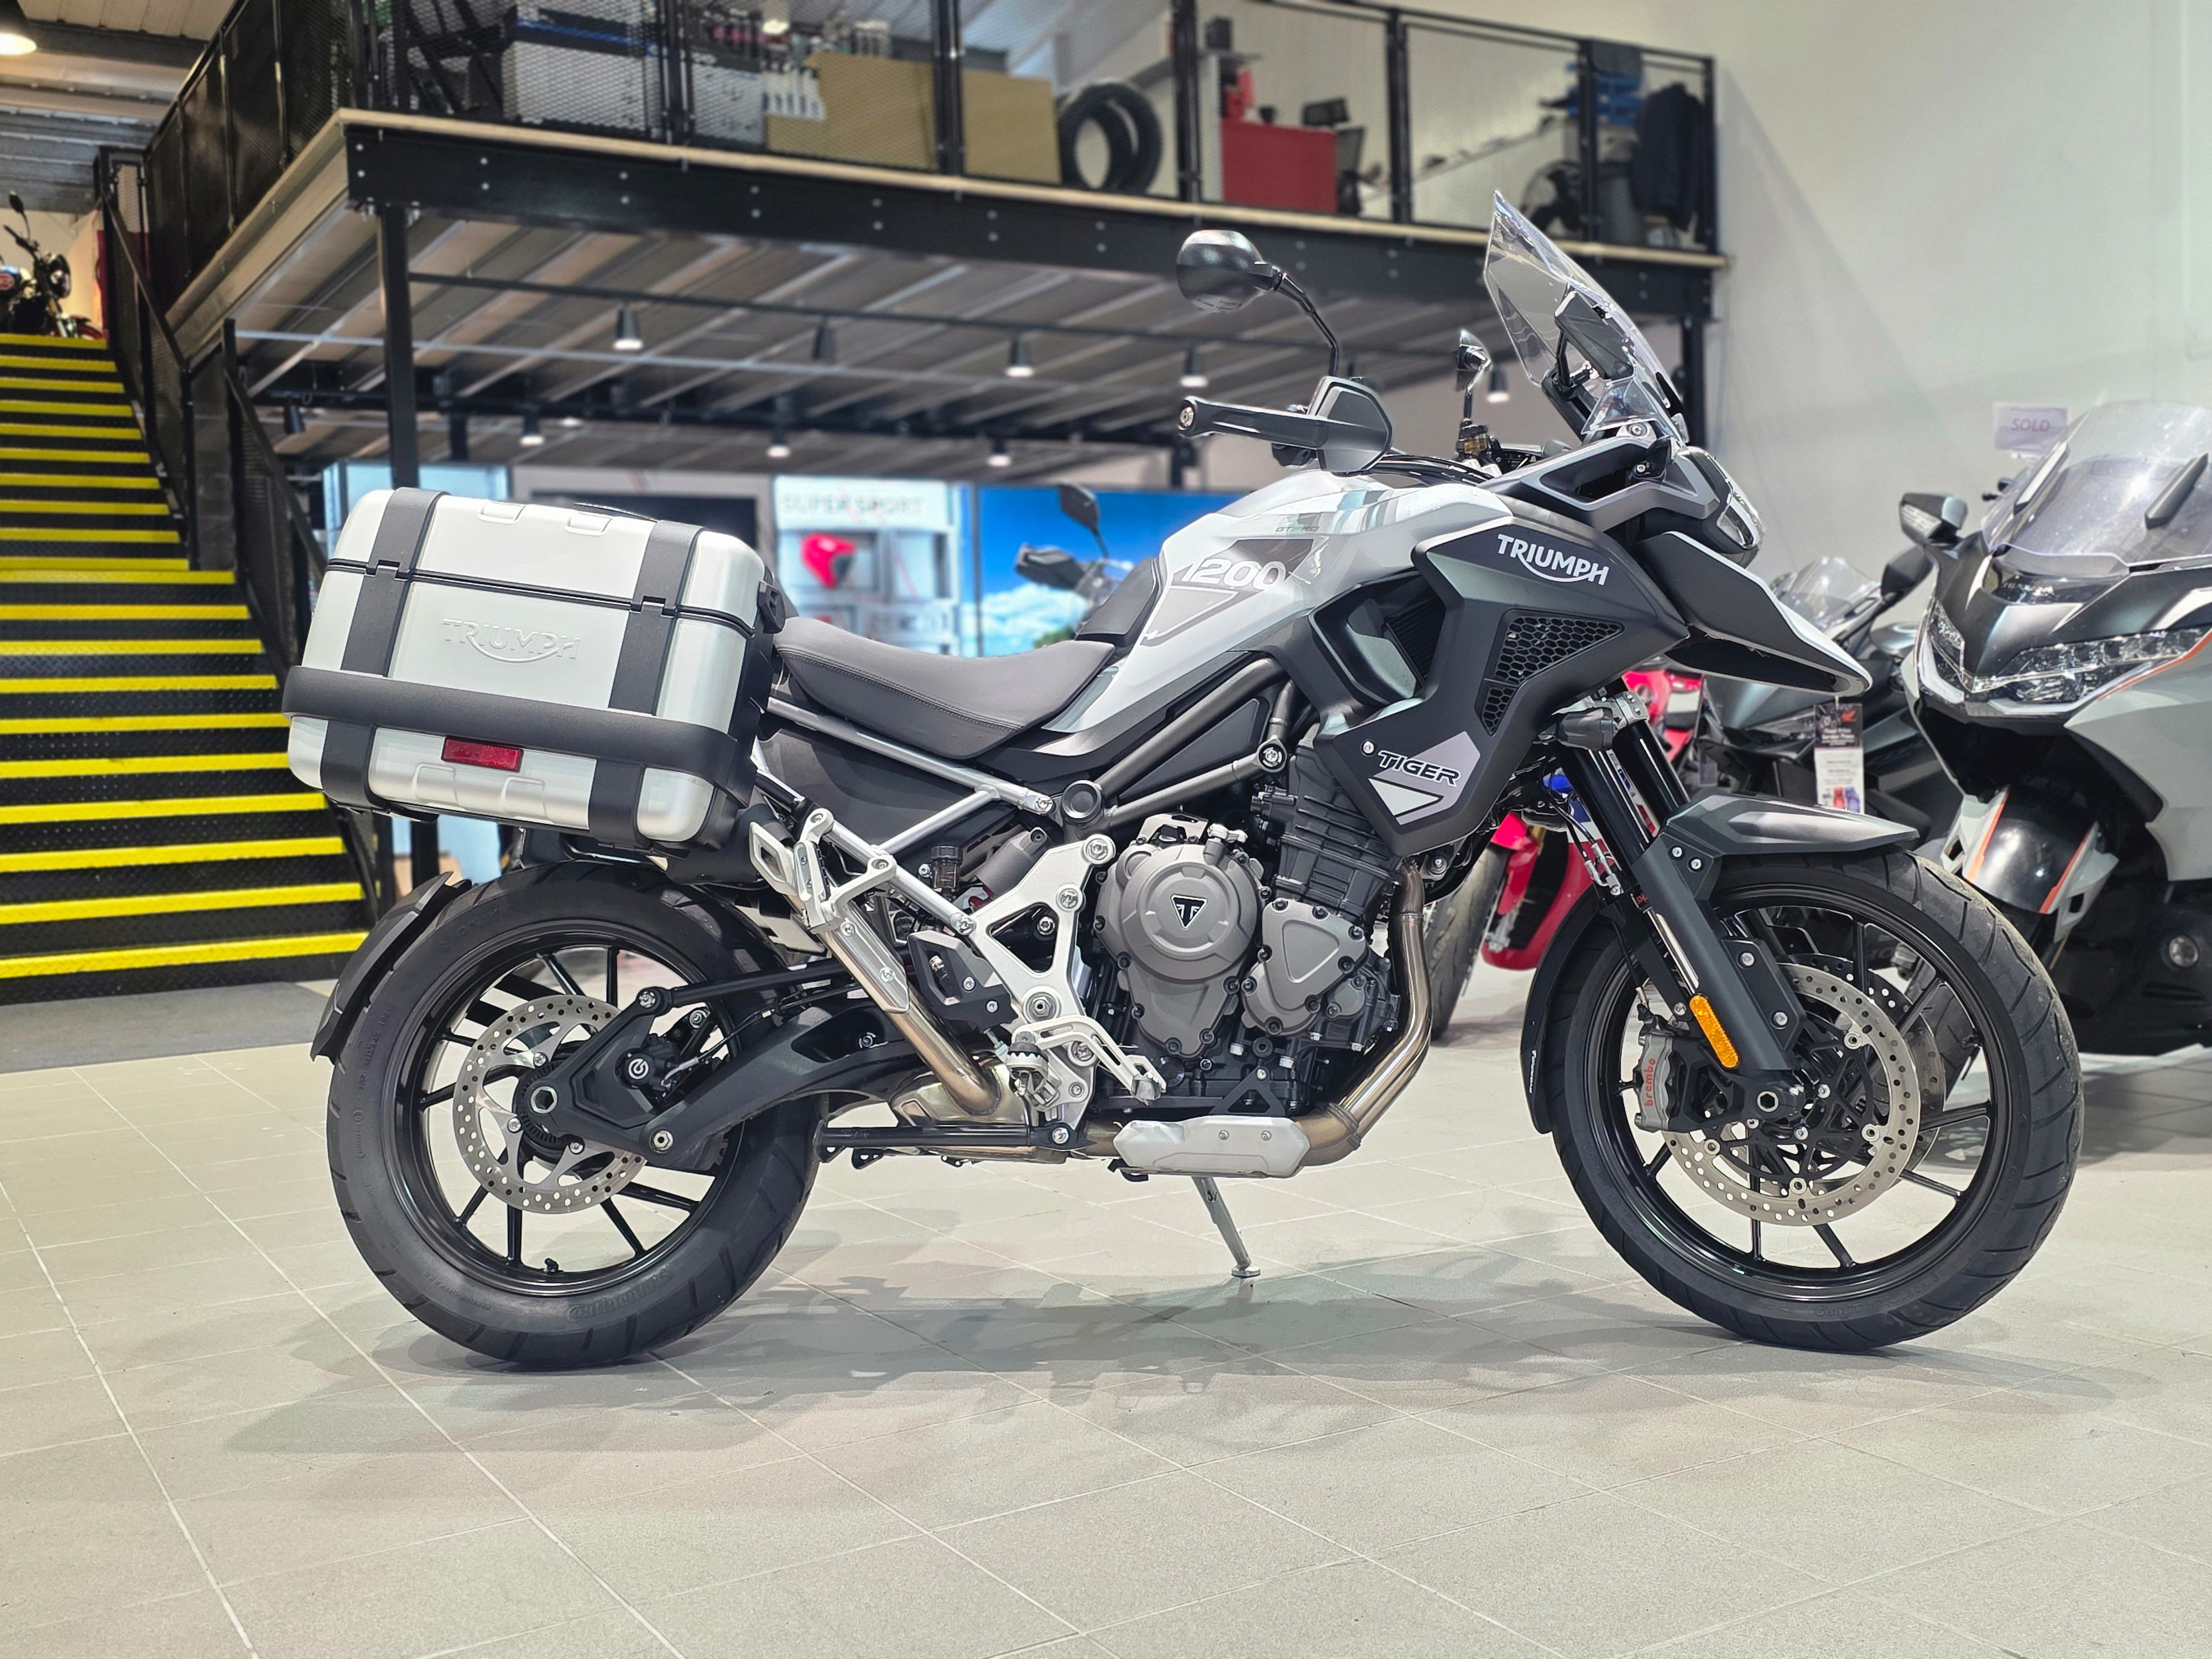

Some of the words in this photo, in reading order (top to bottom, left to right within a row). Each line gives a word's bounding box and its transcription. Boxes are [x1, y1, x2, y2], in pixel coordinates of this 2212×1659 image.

[2012, 418, 2051, 431] SOLD
[783, 493, 849, 514] SUPER
[855, 495, 922, 516] SPORT
[1181, 559, 1286, 590] 1200
[1498, 534, 1609, 585] TRIUMPH
[443, 619, 581, 663] TRIUMPH
[1378, 752, 1460, 787] TIGER
[1644, 1058, 1656, 1107] brembo
[565, 1273, 660, 1323] Continental
